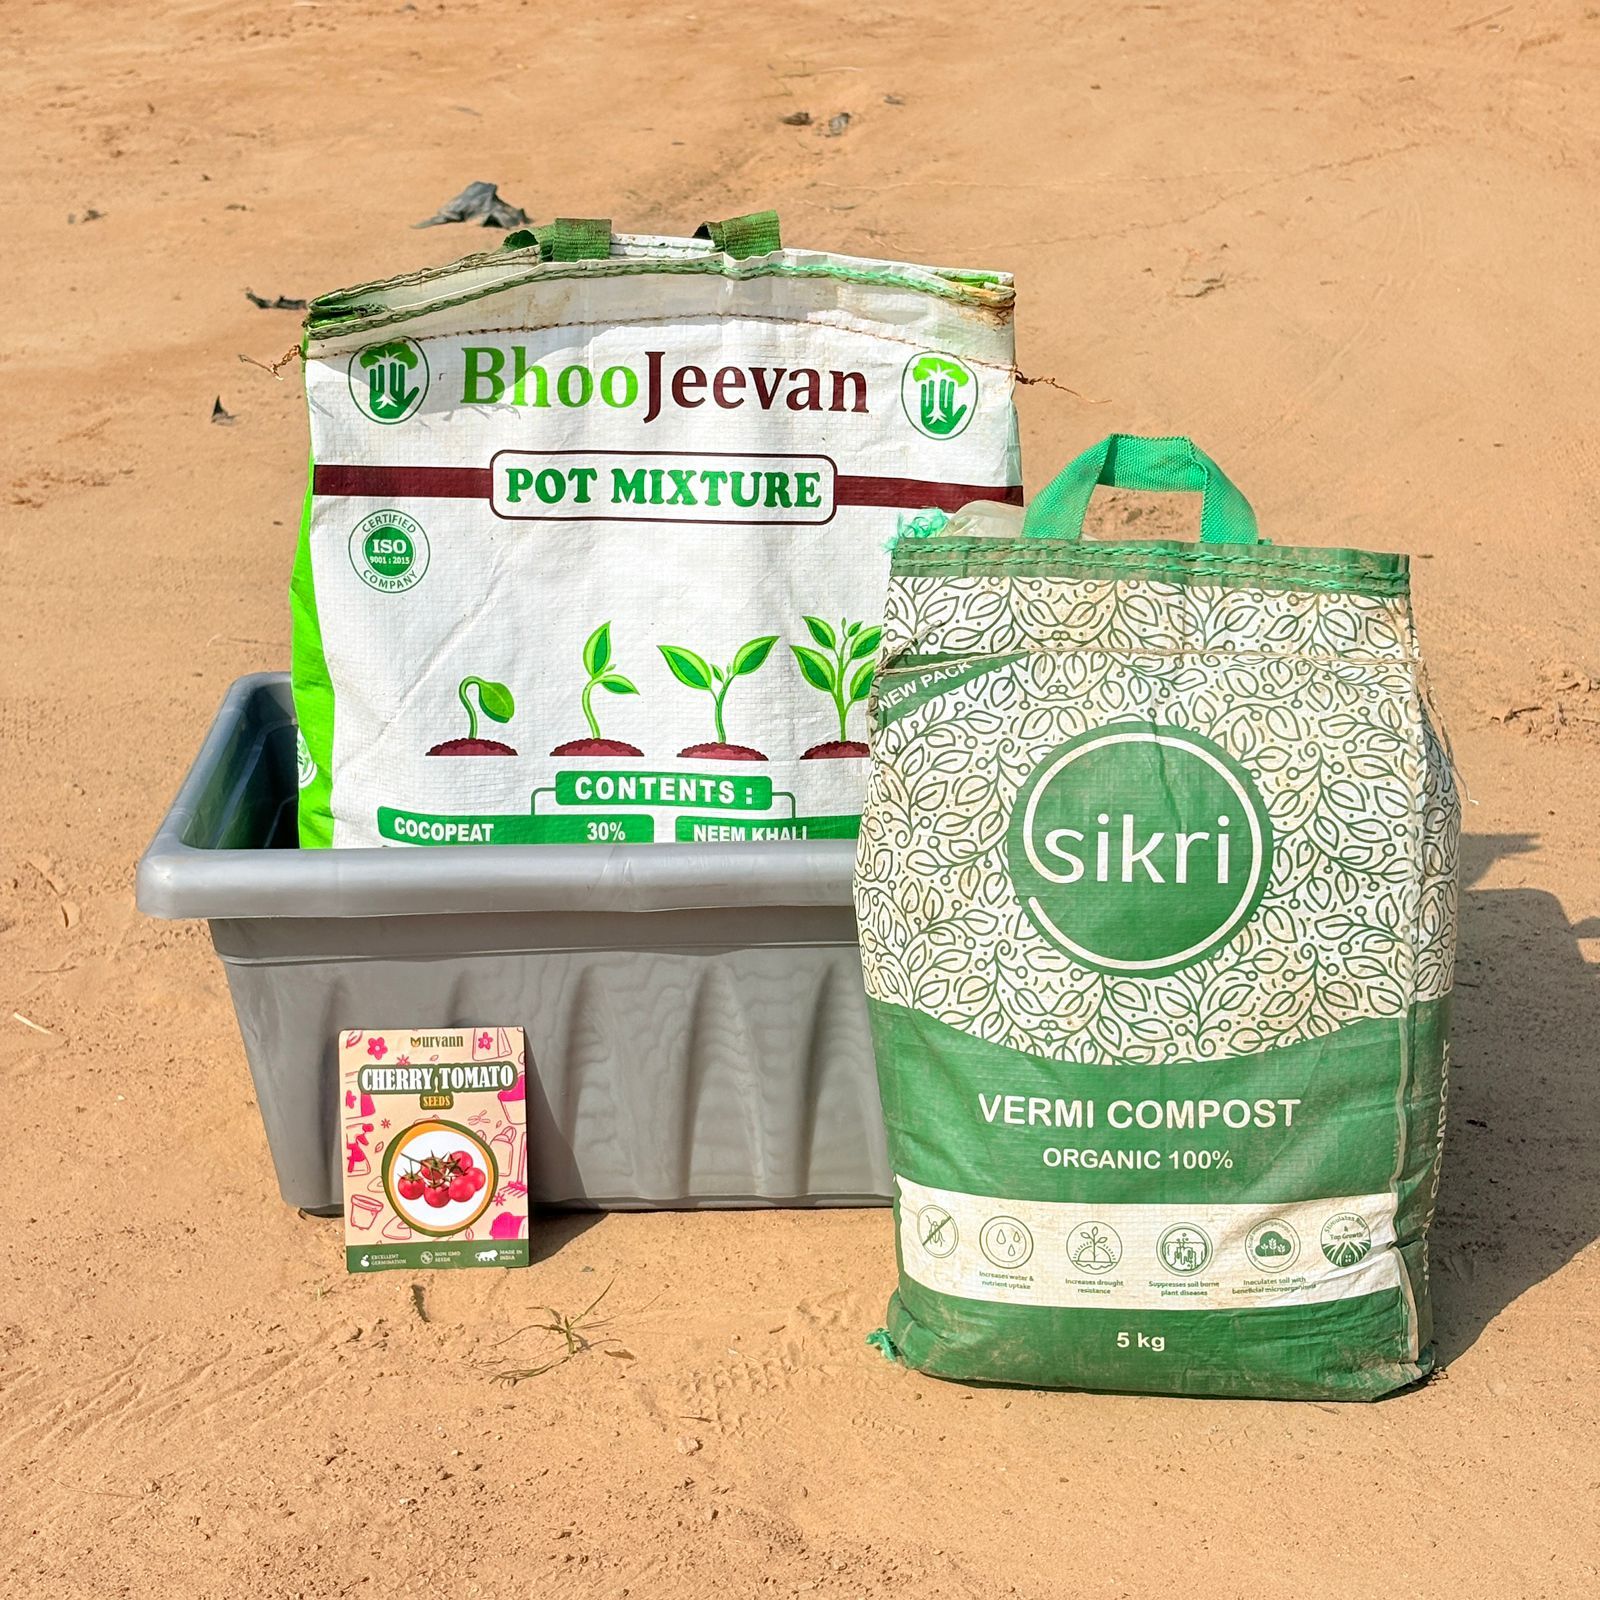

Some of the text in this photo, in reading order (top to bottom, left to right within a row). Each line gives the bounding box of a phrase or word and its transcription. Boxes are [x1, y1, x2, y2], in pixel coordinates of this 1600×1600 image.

[460, 346, 869, 424] BhooJeevan
[505, 467, 822, 508] POT MIXTURE
[362, 513, 416, 533] CERTIFIED
[372, 538, 407, 554] ISO
[363, 569, 418, 589] COMPANY
[878, 661, 973, 712] NEW PACK
[575, 775, 735, 804] CONTENTS
[394, 817, 626, 842] COCOPEAT 30%
[693, 824, 746, 842] NEEM
[1044, 813, 1230, 885] sikri
[361, 1065, 514, 1091] CHERRY TOMATO
[423, 1096, 451, 1107] SEEDS
[978, 1093, 1301, 1128] VERMI COMPOST
[1042, 1147, 1234, 1170] ORGANIC 100%
[979, 1271, 1008, 1280] Increases
[982, 1280, 1031, 1290] nutrient uptake
[1097, 1279, 1124, 1287] drought
[1161, 1289, 1179, 1297] plant
[1232, 1287, 1264, 1295] beneficial
[1116, 1331, 1165, 1352] 5 kg
